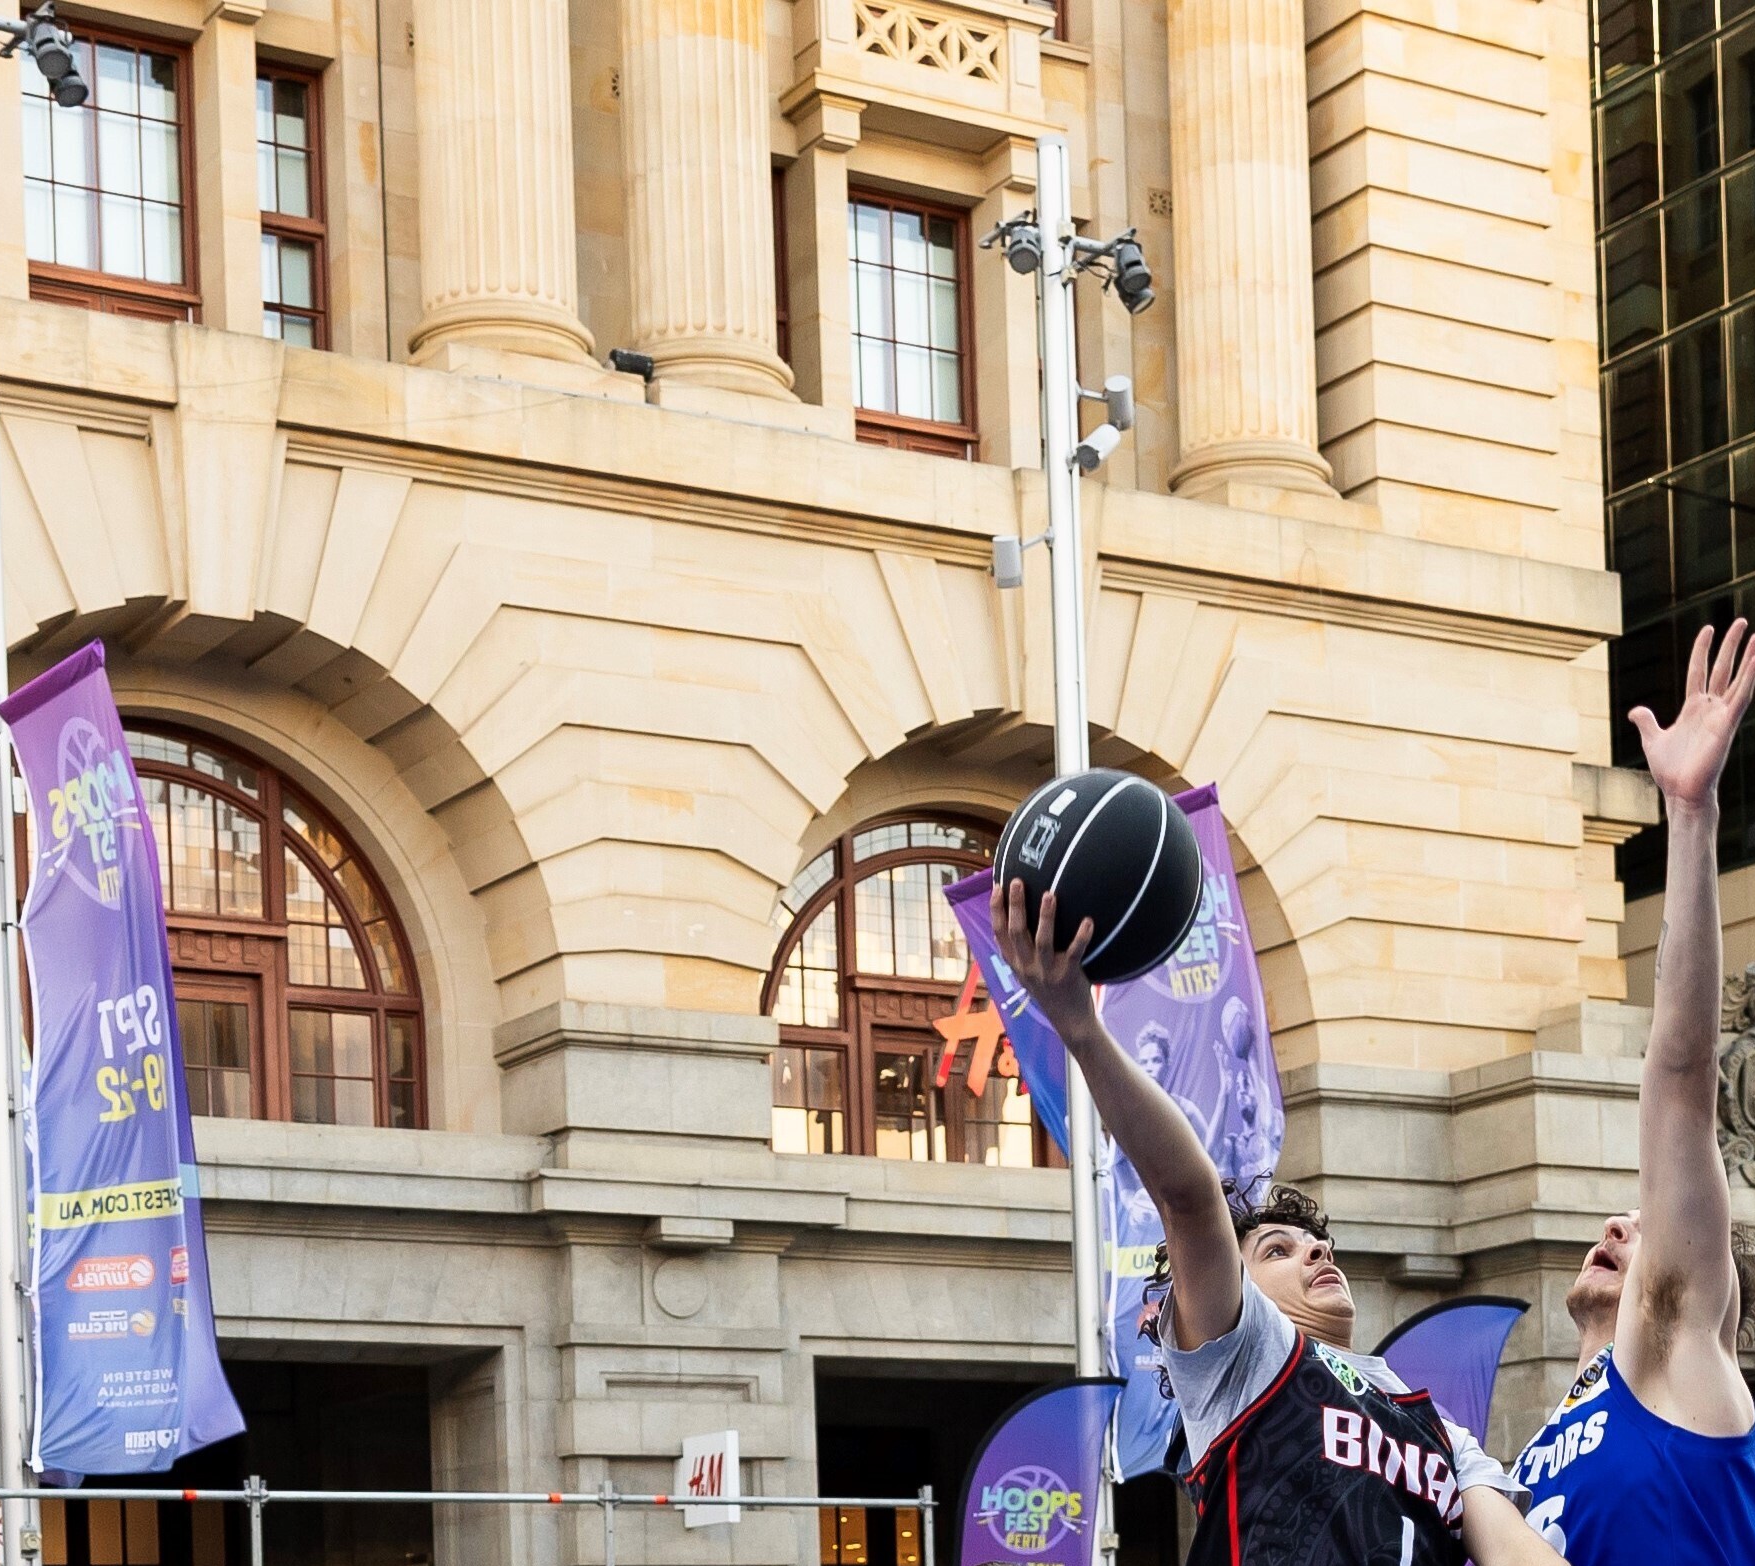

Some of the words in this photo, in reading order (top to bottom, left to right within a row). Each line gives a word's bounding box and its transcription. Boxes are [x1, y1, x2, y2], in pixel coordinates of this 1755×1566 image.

[981, 1486, 1082, 1517] HOOPS
[1004, 1512, 1053, 1533] FEST
[1006, 1532, 1047, 1550] PERTH
